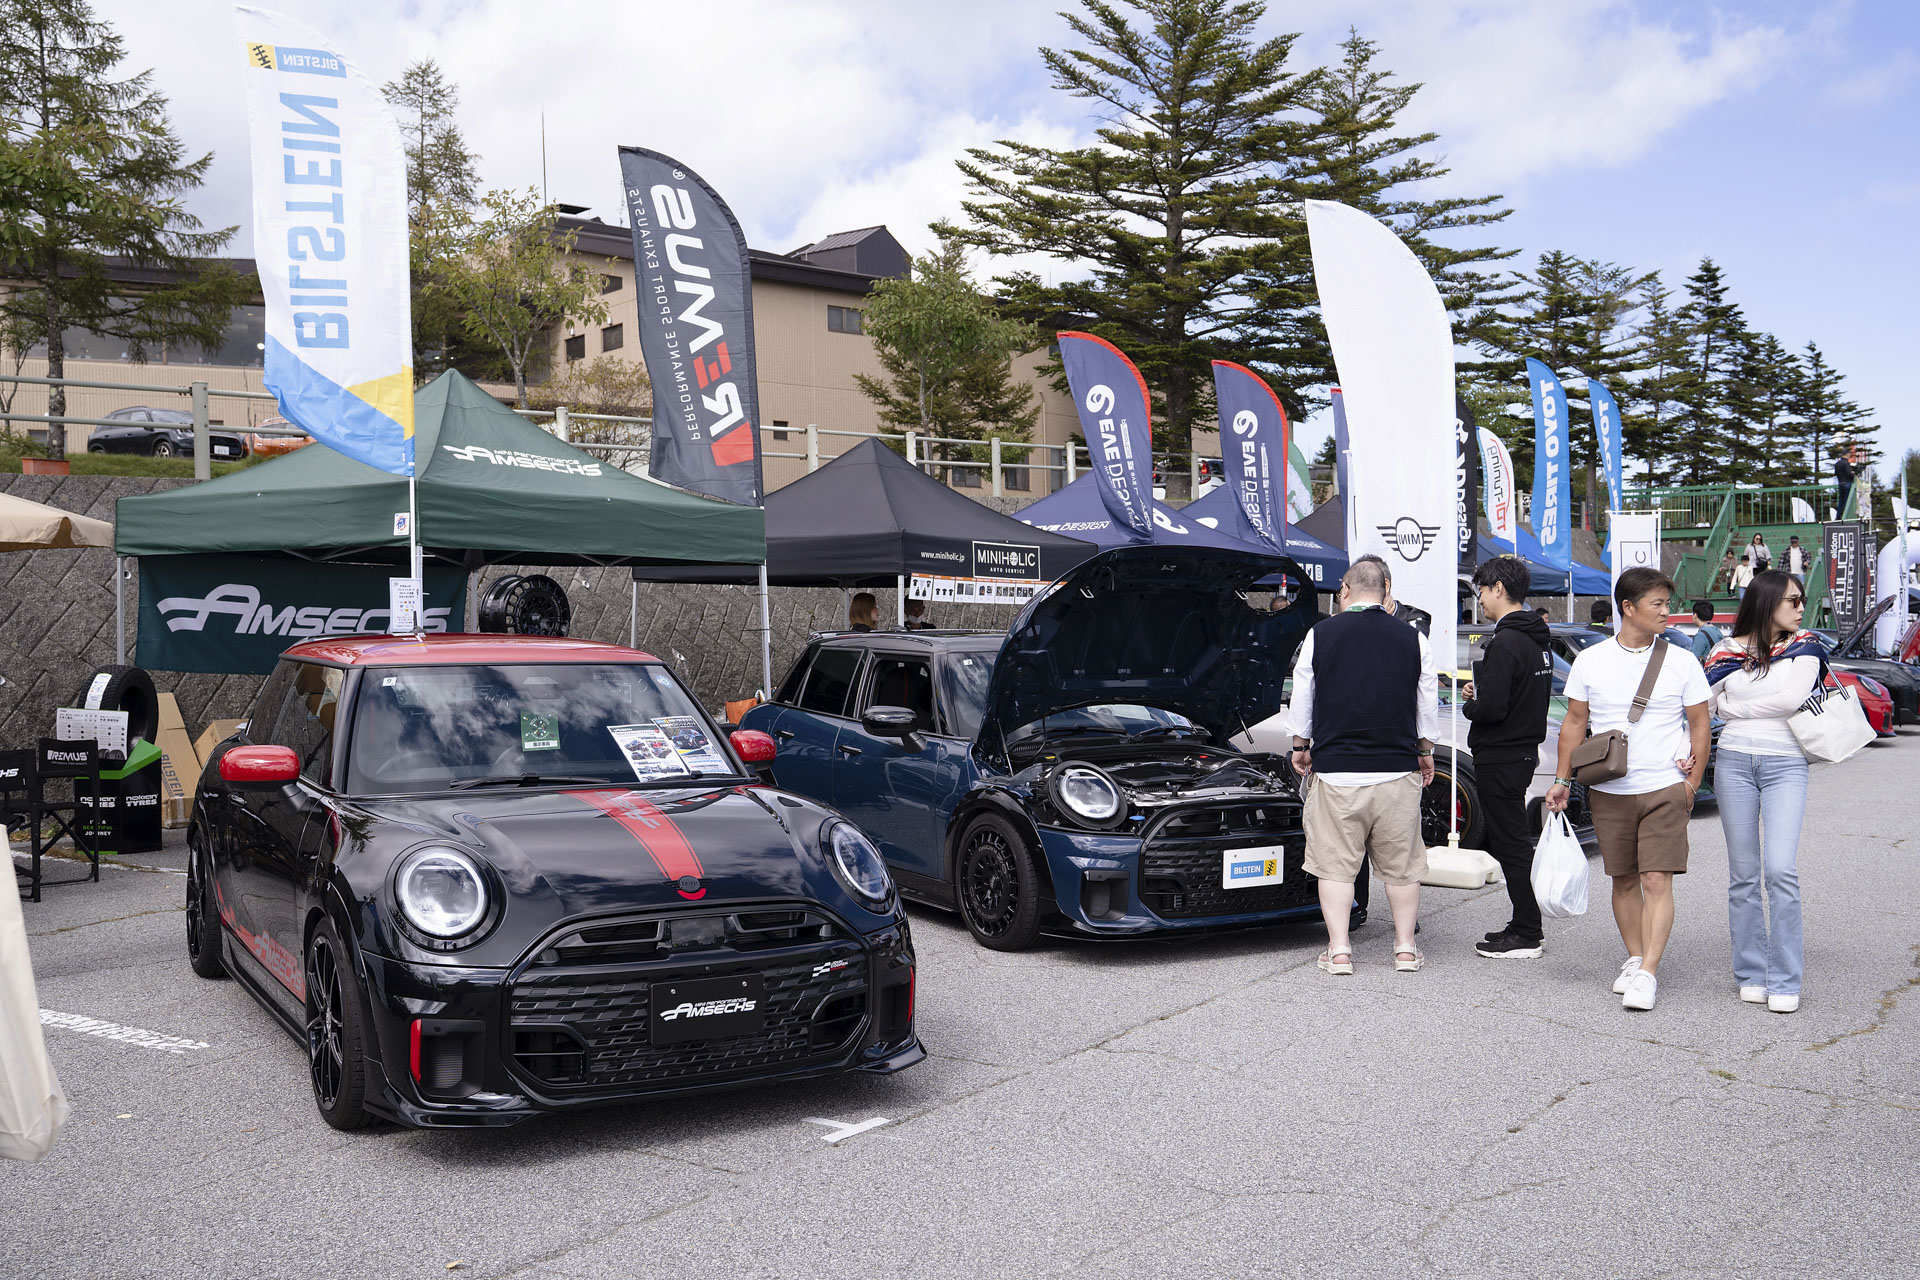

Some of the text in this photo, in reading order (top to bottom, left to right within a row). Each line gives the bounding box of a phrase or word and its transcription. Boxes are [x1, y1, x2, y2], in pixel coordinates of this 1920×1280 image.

[494, 449, 512, 457] MINI
[443, 445, 603, 477] AMSECHS
[920, 551, 965, 563] www.miniholic.jp
[977, 549, 1036, 567] MINIHOLIC
[156, 583, 451, 637] AMSECS
[52, 751, 88, 762] REMUS
[126, 799, 157, 807] TYRES
[1233, 864, 1261, 875] BILSTEIN
[659, 1000, 757, 1021] AMSECHS
